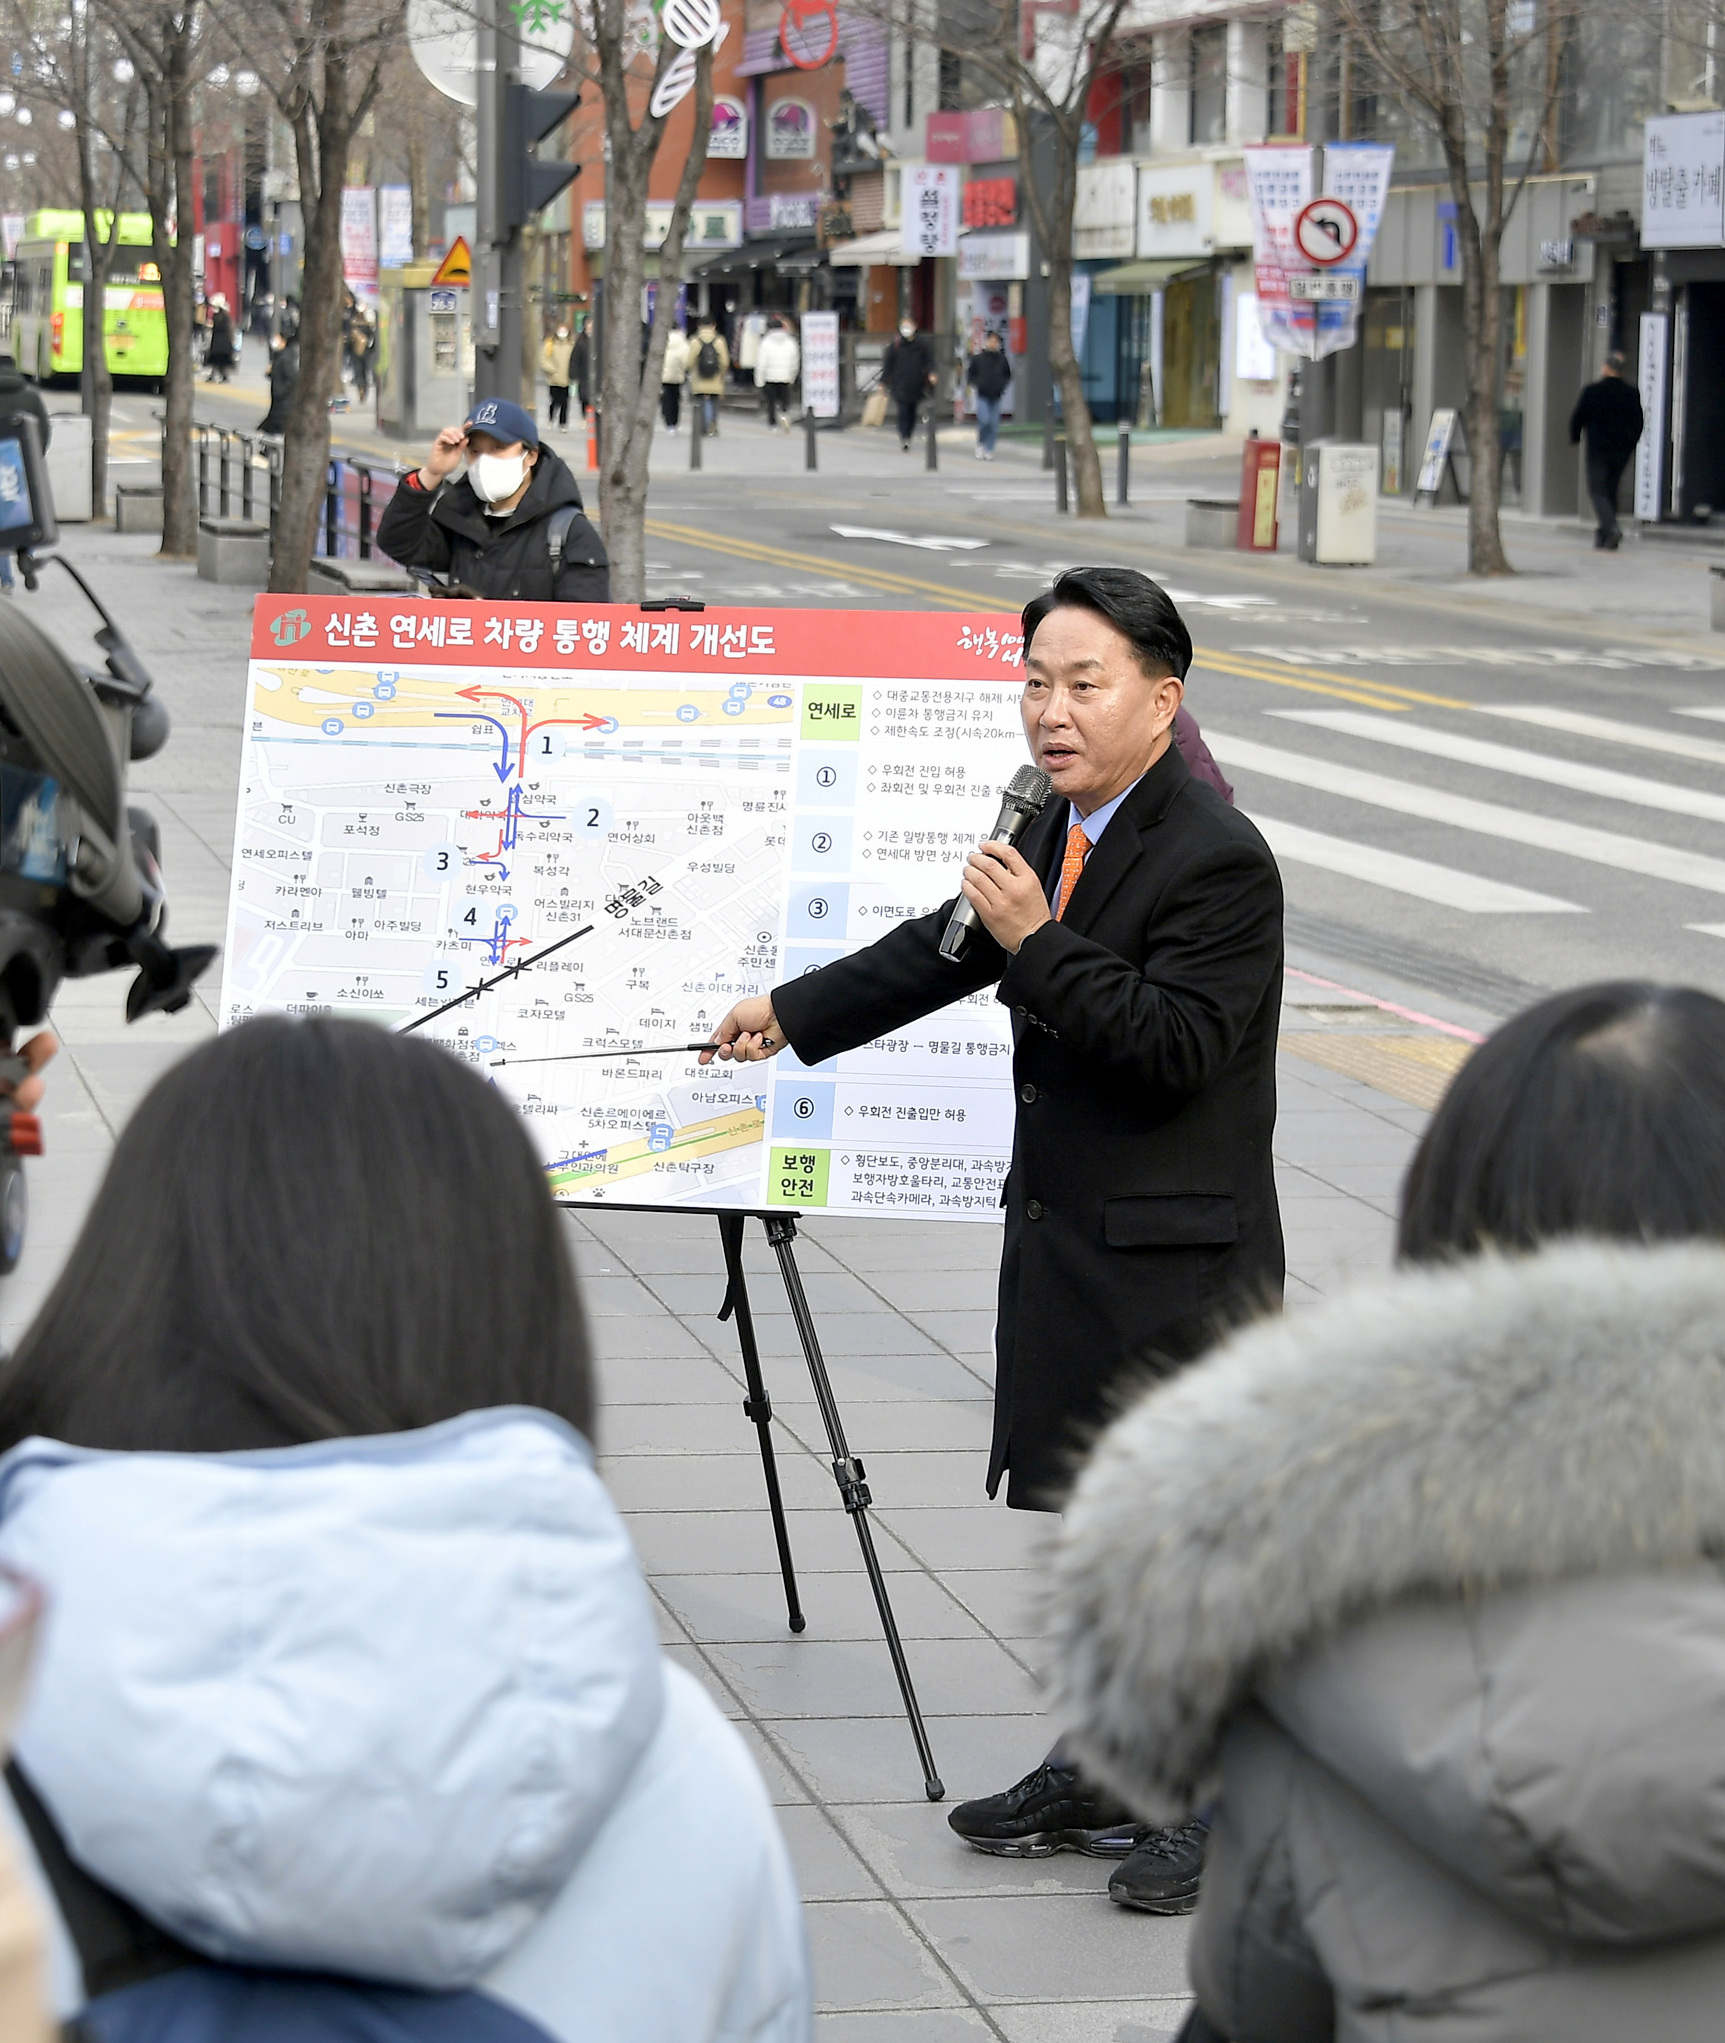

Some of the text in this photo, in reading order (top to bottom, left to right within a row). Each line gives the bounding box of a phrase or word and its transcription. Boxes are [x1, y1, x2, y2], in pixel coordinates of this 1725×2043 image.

[324, 611, 776, 659] 신촌 연세로 차량 통행 체계 개선도
[956, 625, 999, 659] 행복
[887, 690, 976, 704] 대중교통전용지구
[979, 692, 1003, 704] 해제
[808, 702, 857, 720] 연세로
[885, 707, 994, 722] 이륜차 통행금지 유지
[884, 725, 930, 738] 제한속도
[541, 736, 554, 755] 1
[882, 765, 967, 779] 우회전 진입 허용
[384, 783, 432, 795] 신촌극장
[881, 782, 915, 795] 좌회전
[919, 783, 929, 796] 및
[933, 783, 967, 796] 우회전
[970, 784, 992, 797] 진출
[278, 814, 296, 825] CU
[394, 812, 425, 823] GS25
[586, 808, 600, 827] 2
[687, 813, 725, 824] 아웃백
[342, 825, 381, 837] 포석정
[877, 830, 900, 843] 기존
[903, 831, 949, 845] 일방통행
[952, 833, 976, 845] 체계
[607, 832, 656, 844] 연어상회
[241, 849, 313, 862] 연세오피스텔
[436, 852, 449, 871] 3
[876, 848, 911, 861] 연세대
[914, 849, 937, 862] 방면
[940, 850, 963, 862] 상시
[533, 865, 571, 877] 복성각
[686, 861, 736, 874] 우성빌딩
[351, 887, 388, 900] 웰빙텔
[465, 884, 513, 896] 현우약국
[604, 875, 664, 919] 명물길
[534, 898, 596, 911] 어스빌리지
[463, 907, 477, 926] 4
[545, 911, 581, 922] 신촌31
[872, 905, 917, 918] 이면도로
[264, 919, 324, 932] 저스트리브
[373, 919, 422, 932] 아주빌딩
[630, 916, 679, 928] 노브랜드
[345, 930, 369, 941] 아마
[618, 927, 692, 940] 서대문신촌점
[435, 940, 472, 951] 카츠미
[536, 961, 585, 973] 리플레이
[435, 970, 449, 989] 5
[563, 992, 594, 1003] GS25
[517, 1008, 566, 1021] 코자모텔
[639, 1017, 676, 1030] 데이지
[582, 1037, 644, 1049] 크럭스모텔
[863, 1039, 1011, 1056] 스타광장 명물길 통행금지
[601, 1067, 663, 1080] 바론드파리
[684, 1067, 734, 1080] 대현교회
[691, 1092, 760, 1105] 아남오피스
[580, 1106, 667, 1120] 신촌르메이에르
[858, 1105, 967, 1122] 우회전 진출입만 허용
[653, 1161, 715, 1174] 신촌탁구장
[782, 1154, 816, 1174] 보행
[855, 1154, 904, 1170] 횡단보도,
[906, 1156, 968, 1173] 중앙분리대,
[852, 1172, 948, 1190] 보행자방호울타리,
[780, 1178, 814, 1198] 안전
[851, 1190, 936, 1207] 과속단속카메라,
[938, 1193, 997, 1209] 과속방지턱
